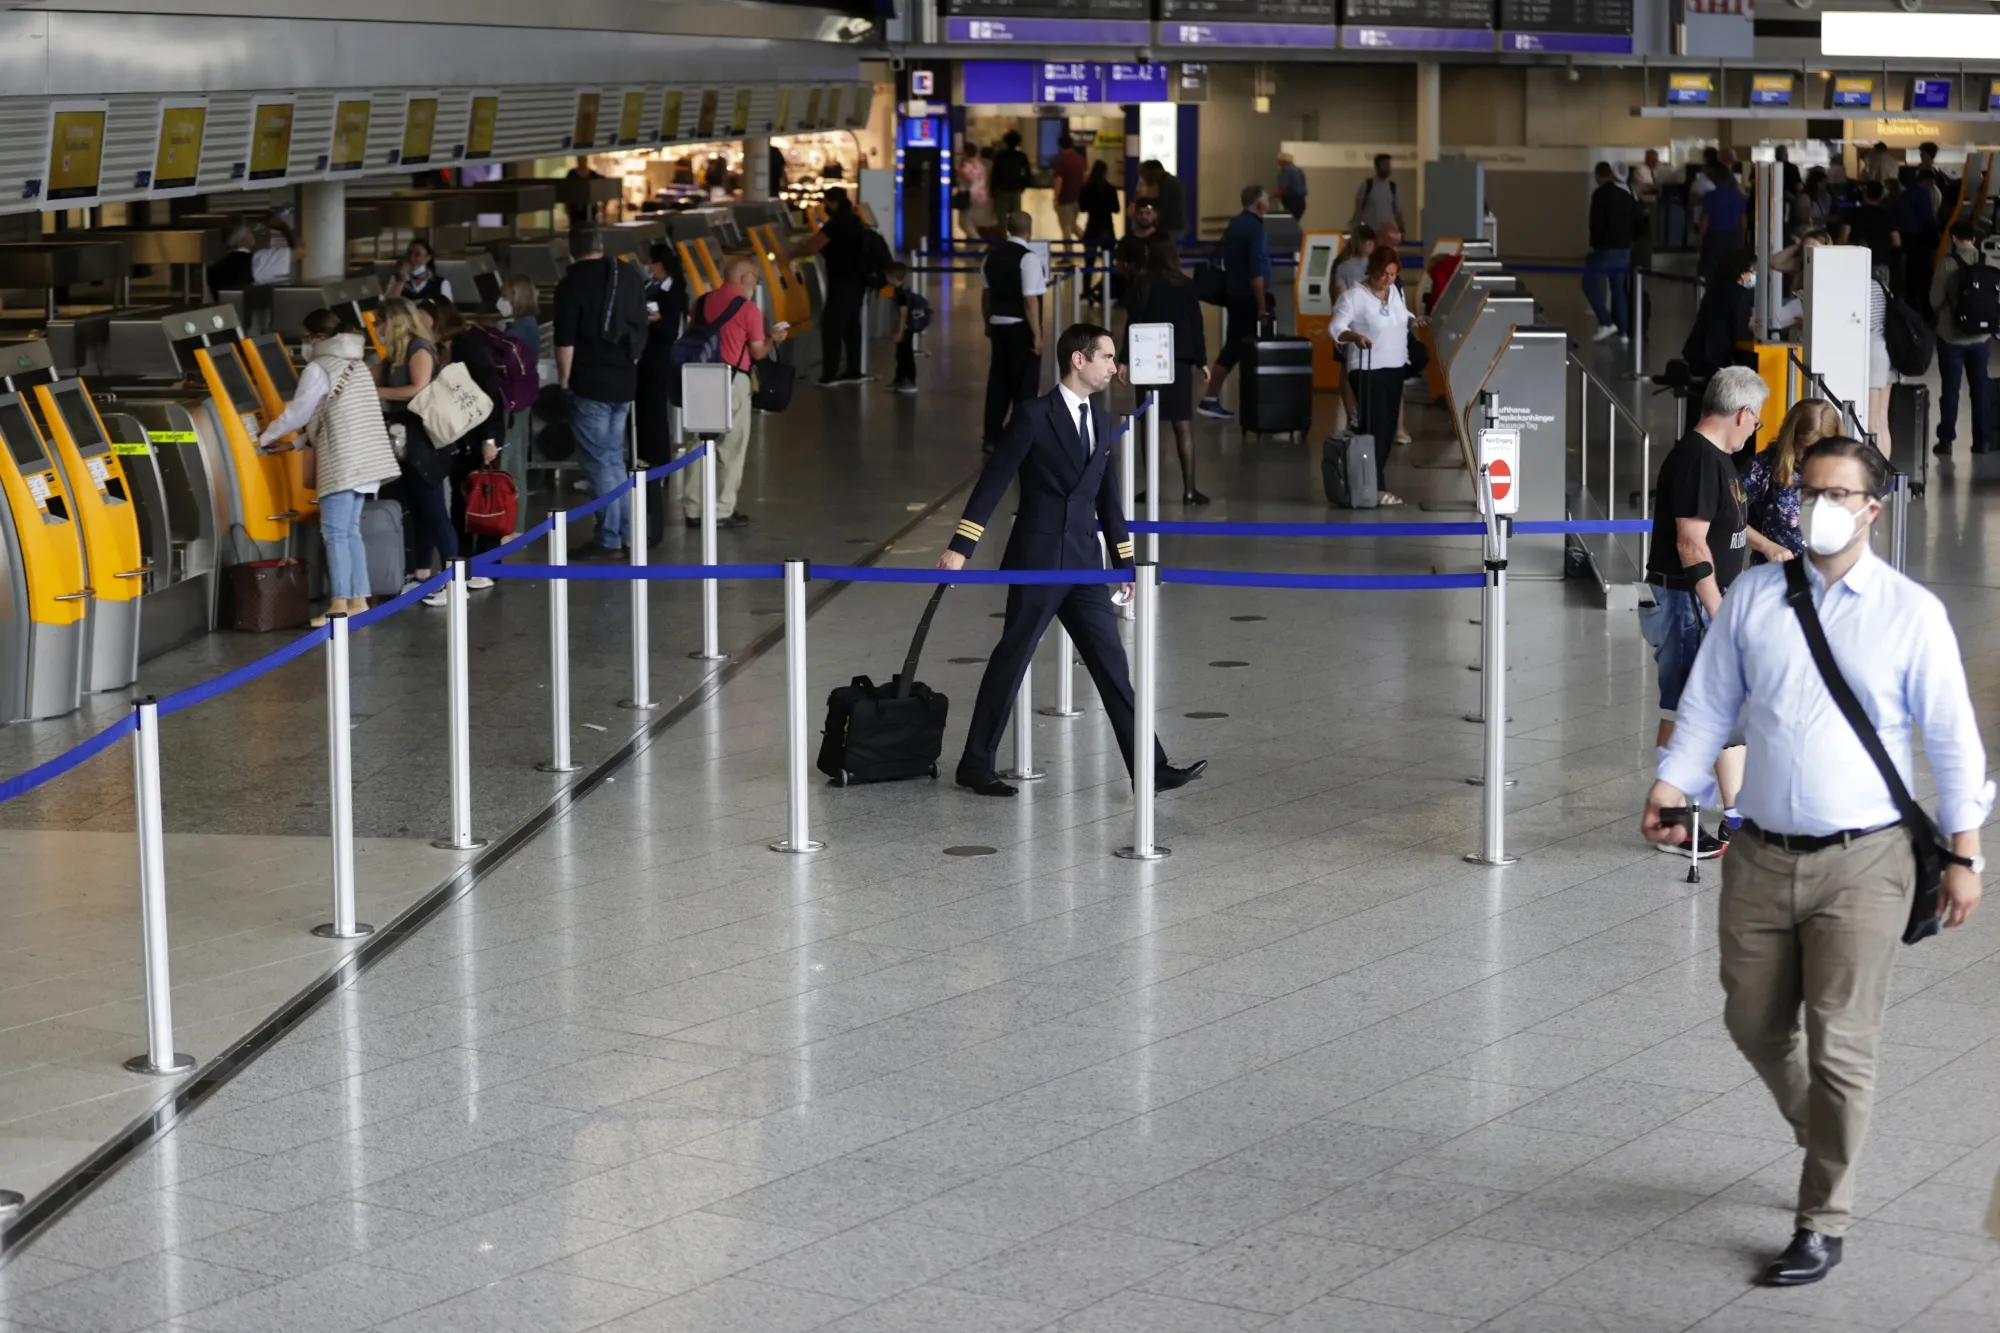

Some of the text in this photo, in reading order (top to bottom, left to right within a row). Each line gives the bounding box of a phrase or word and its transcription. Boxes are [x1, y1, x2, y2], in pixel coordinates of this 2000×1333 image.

[1134, 334, 1140, 342] 1
[1135, 358, 1141, 366] 2
[1496, 414, 1555, 422] epäckanhänger
